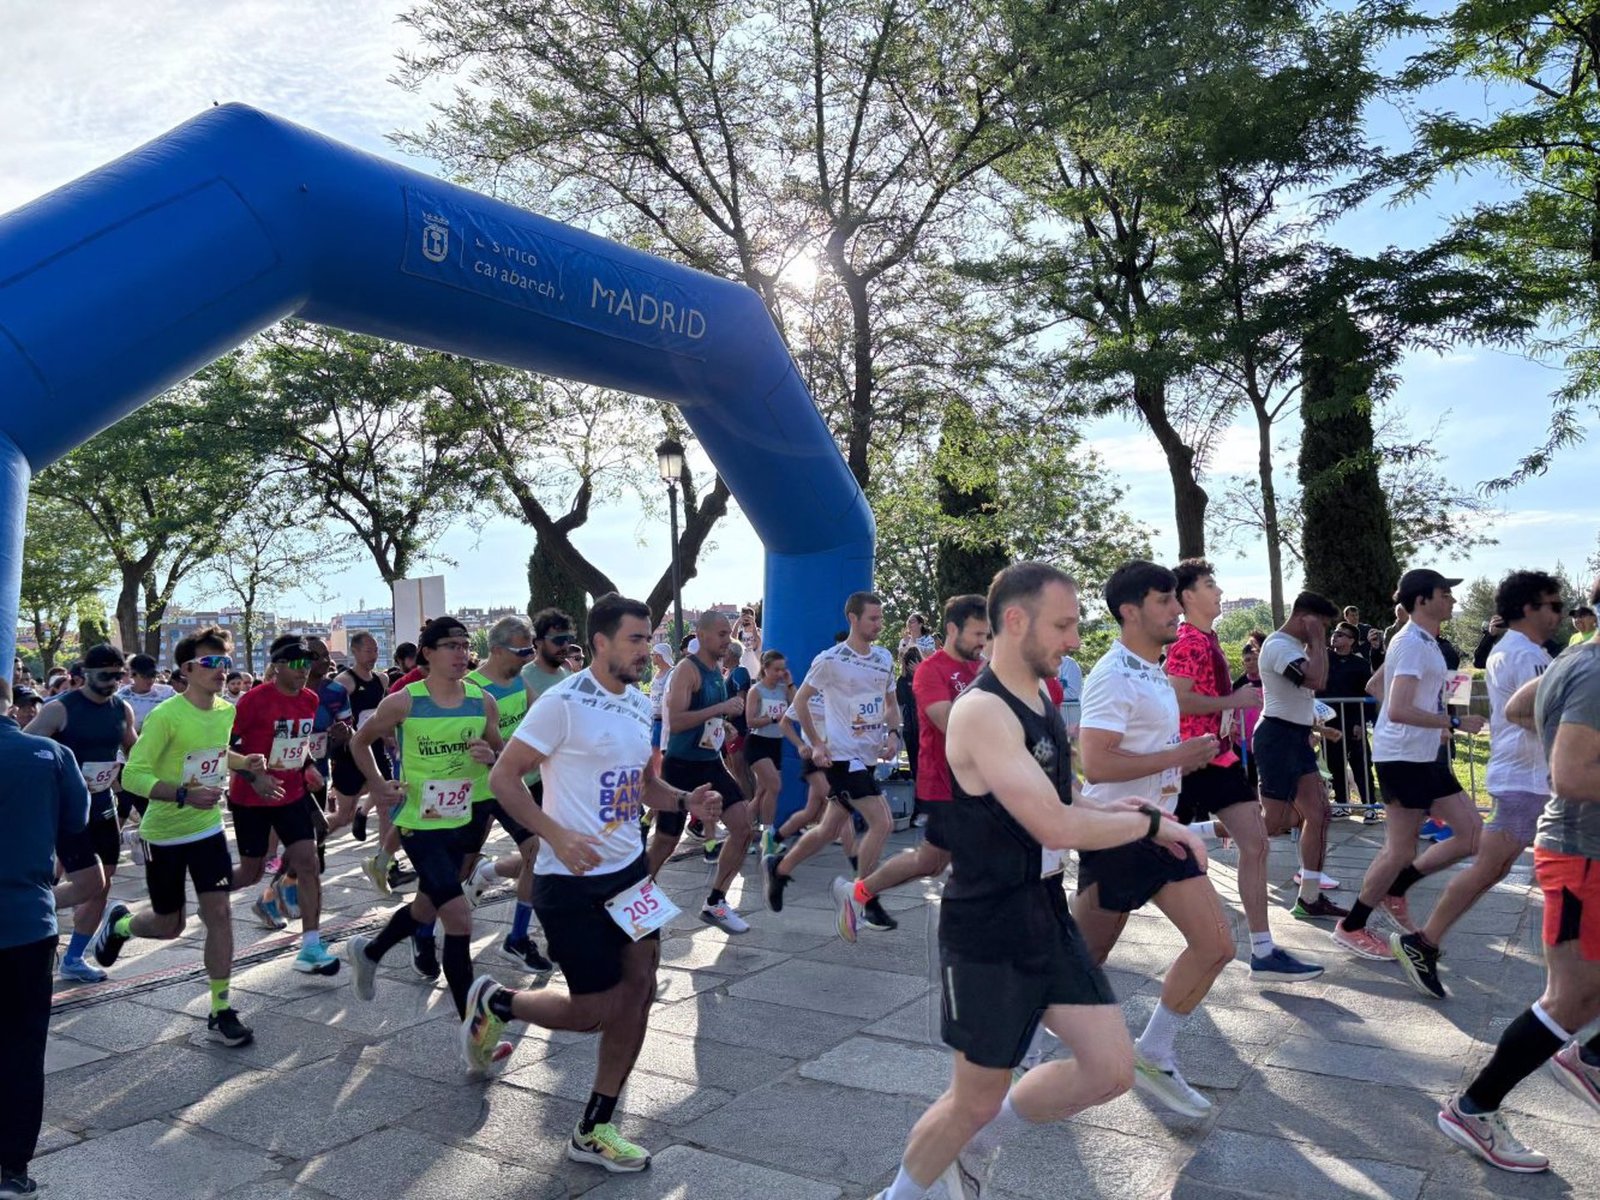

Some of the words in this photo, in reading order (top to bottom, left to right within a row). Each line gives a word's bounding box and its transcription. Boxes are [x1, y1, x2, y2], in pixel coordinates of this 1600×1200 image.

[591, 277, 706, 339] MADRID
[859, 702, 879, 715] 301
[283, 747, 302, 759] 159
[201, 759, 218, 774] 97
[96, 770, 111, 782] 65
[438, 791, 466, 806] 129
[623, 893, 658, 922] 205
